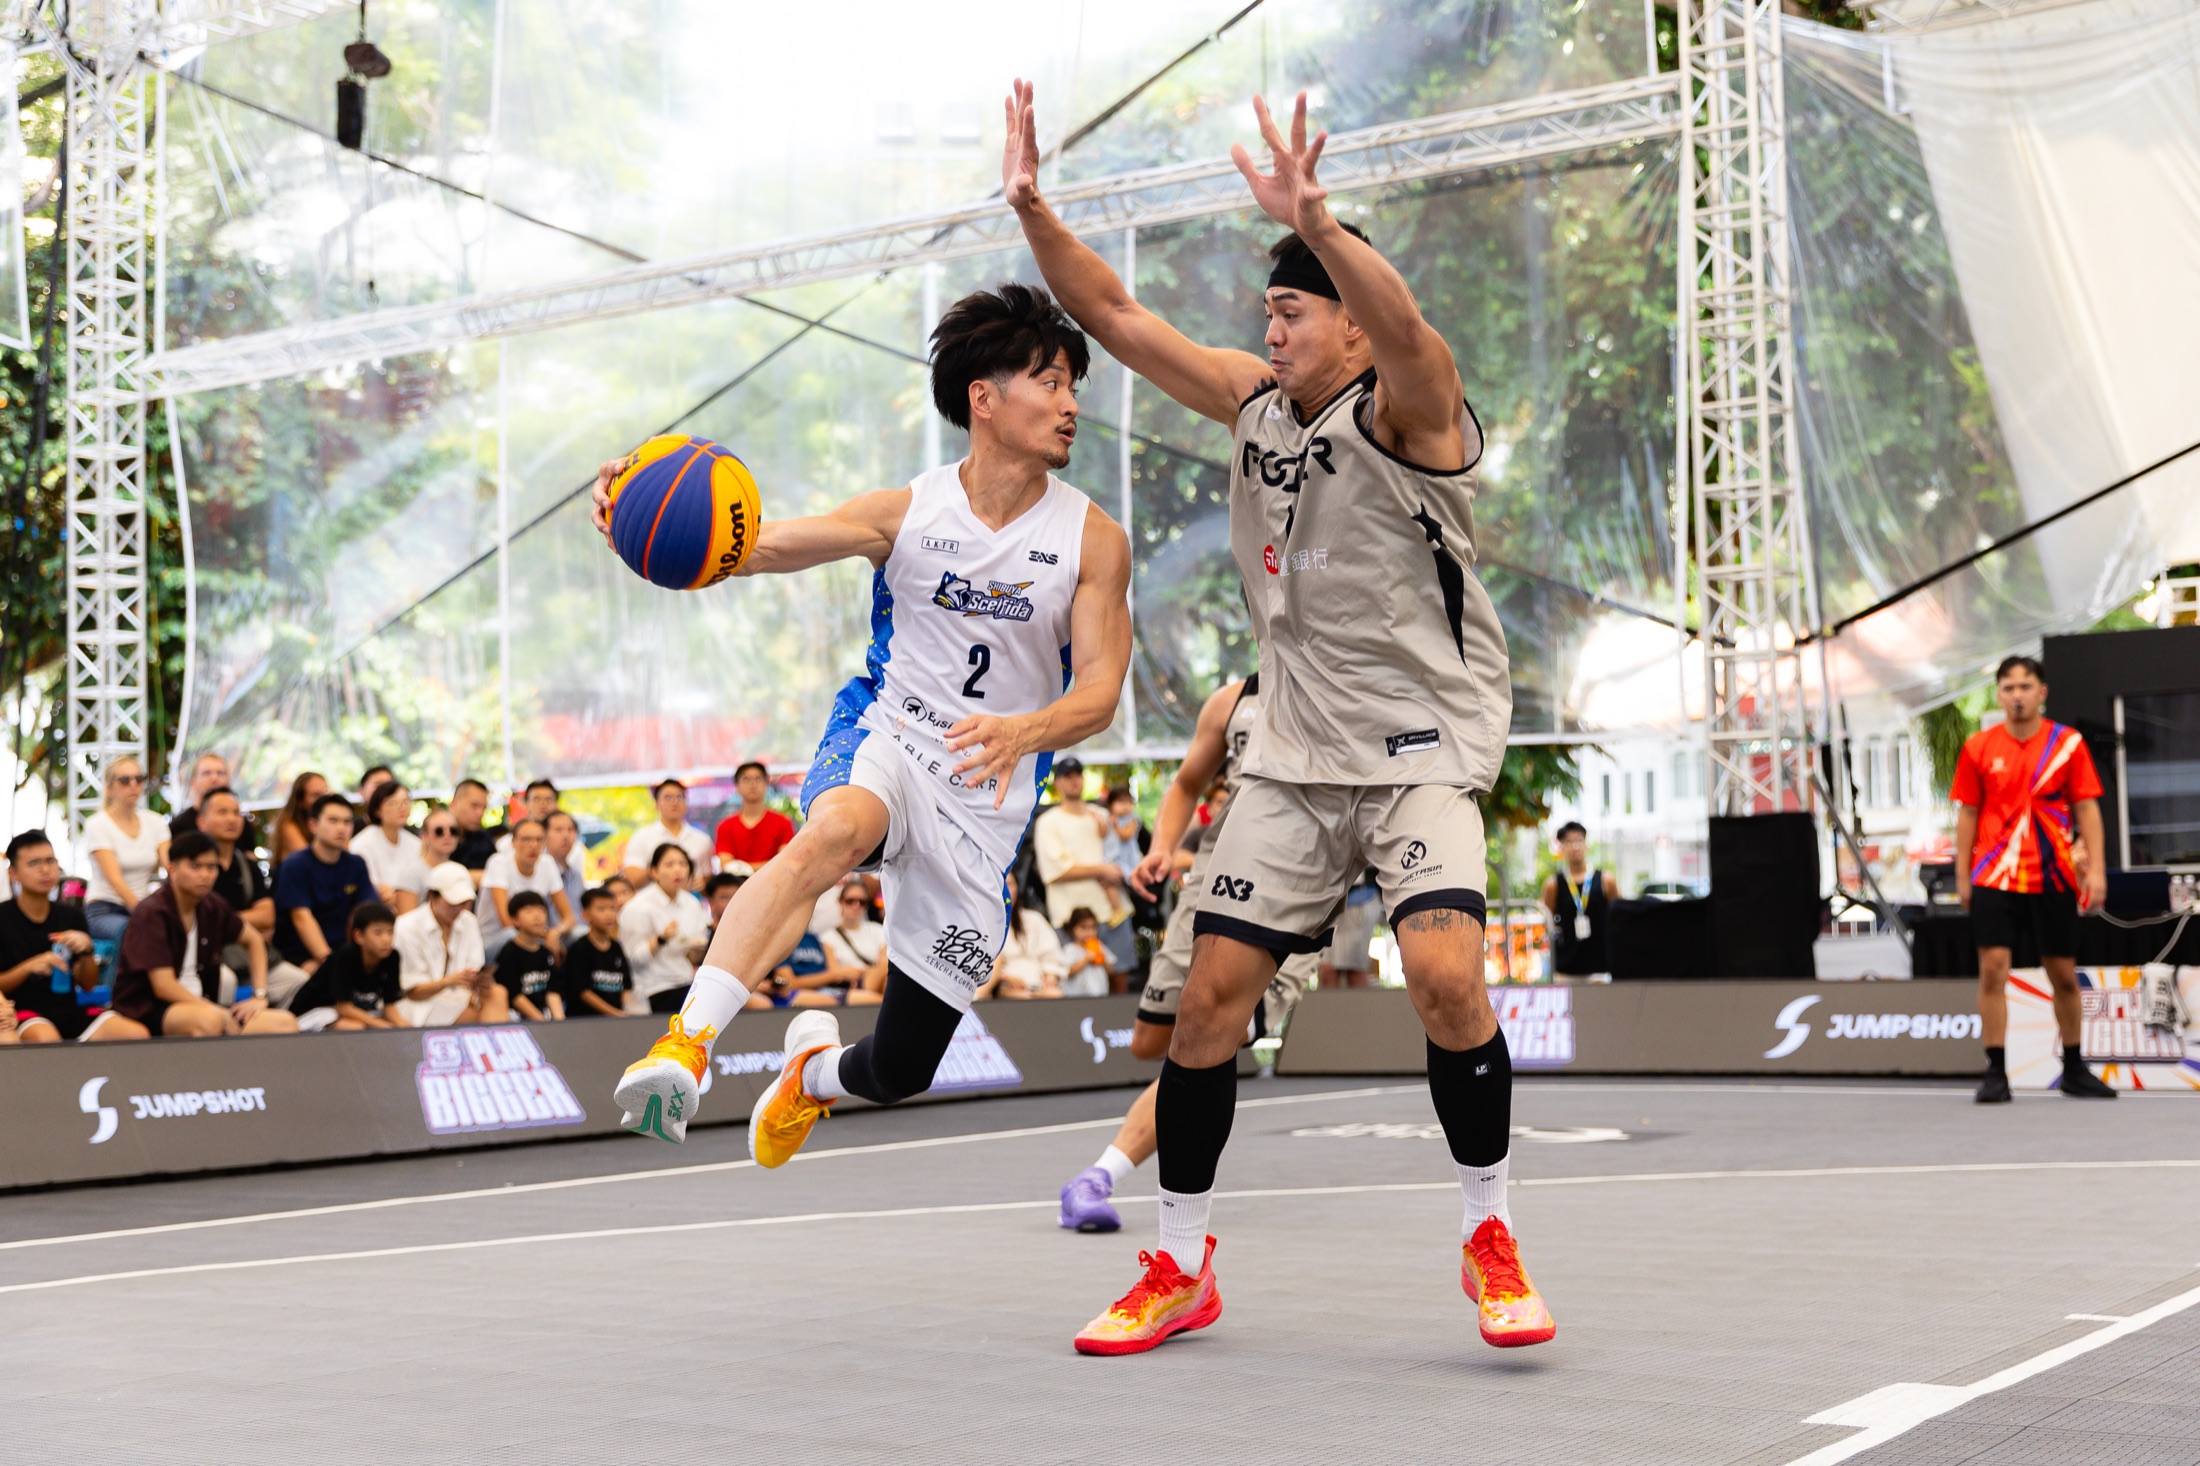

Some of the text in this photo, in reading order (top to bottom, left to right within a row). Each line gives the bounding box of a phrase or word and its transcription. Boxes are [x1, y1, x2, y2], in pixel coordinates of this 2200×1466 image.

[925, 539, 955, 551] AKTR
[987, 580, 1022, 596] SHIBUYA
[962, 644, 991, 699] 2
[925, 955, 975, 993] SENCHA KOMBU
[1826, 1013, 1983, 1039] JUMPSHOT
[129, 1087, 267, 1120] JUMPSHOT
[421, 1067, 582, 1129] BIGGER
